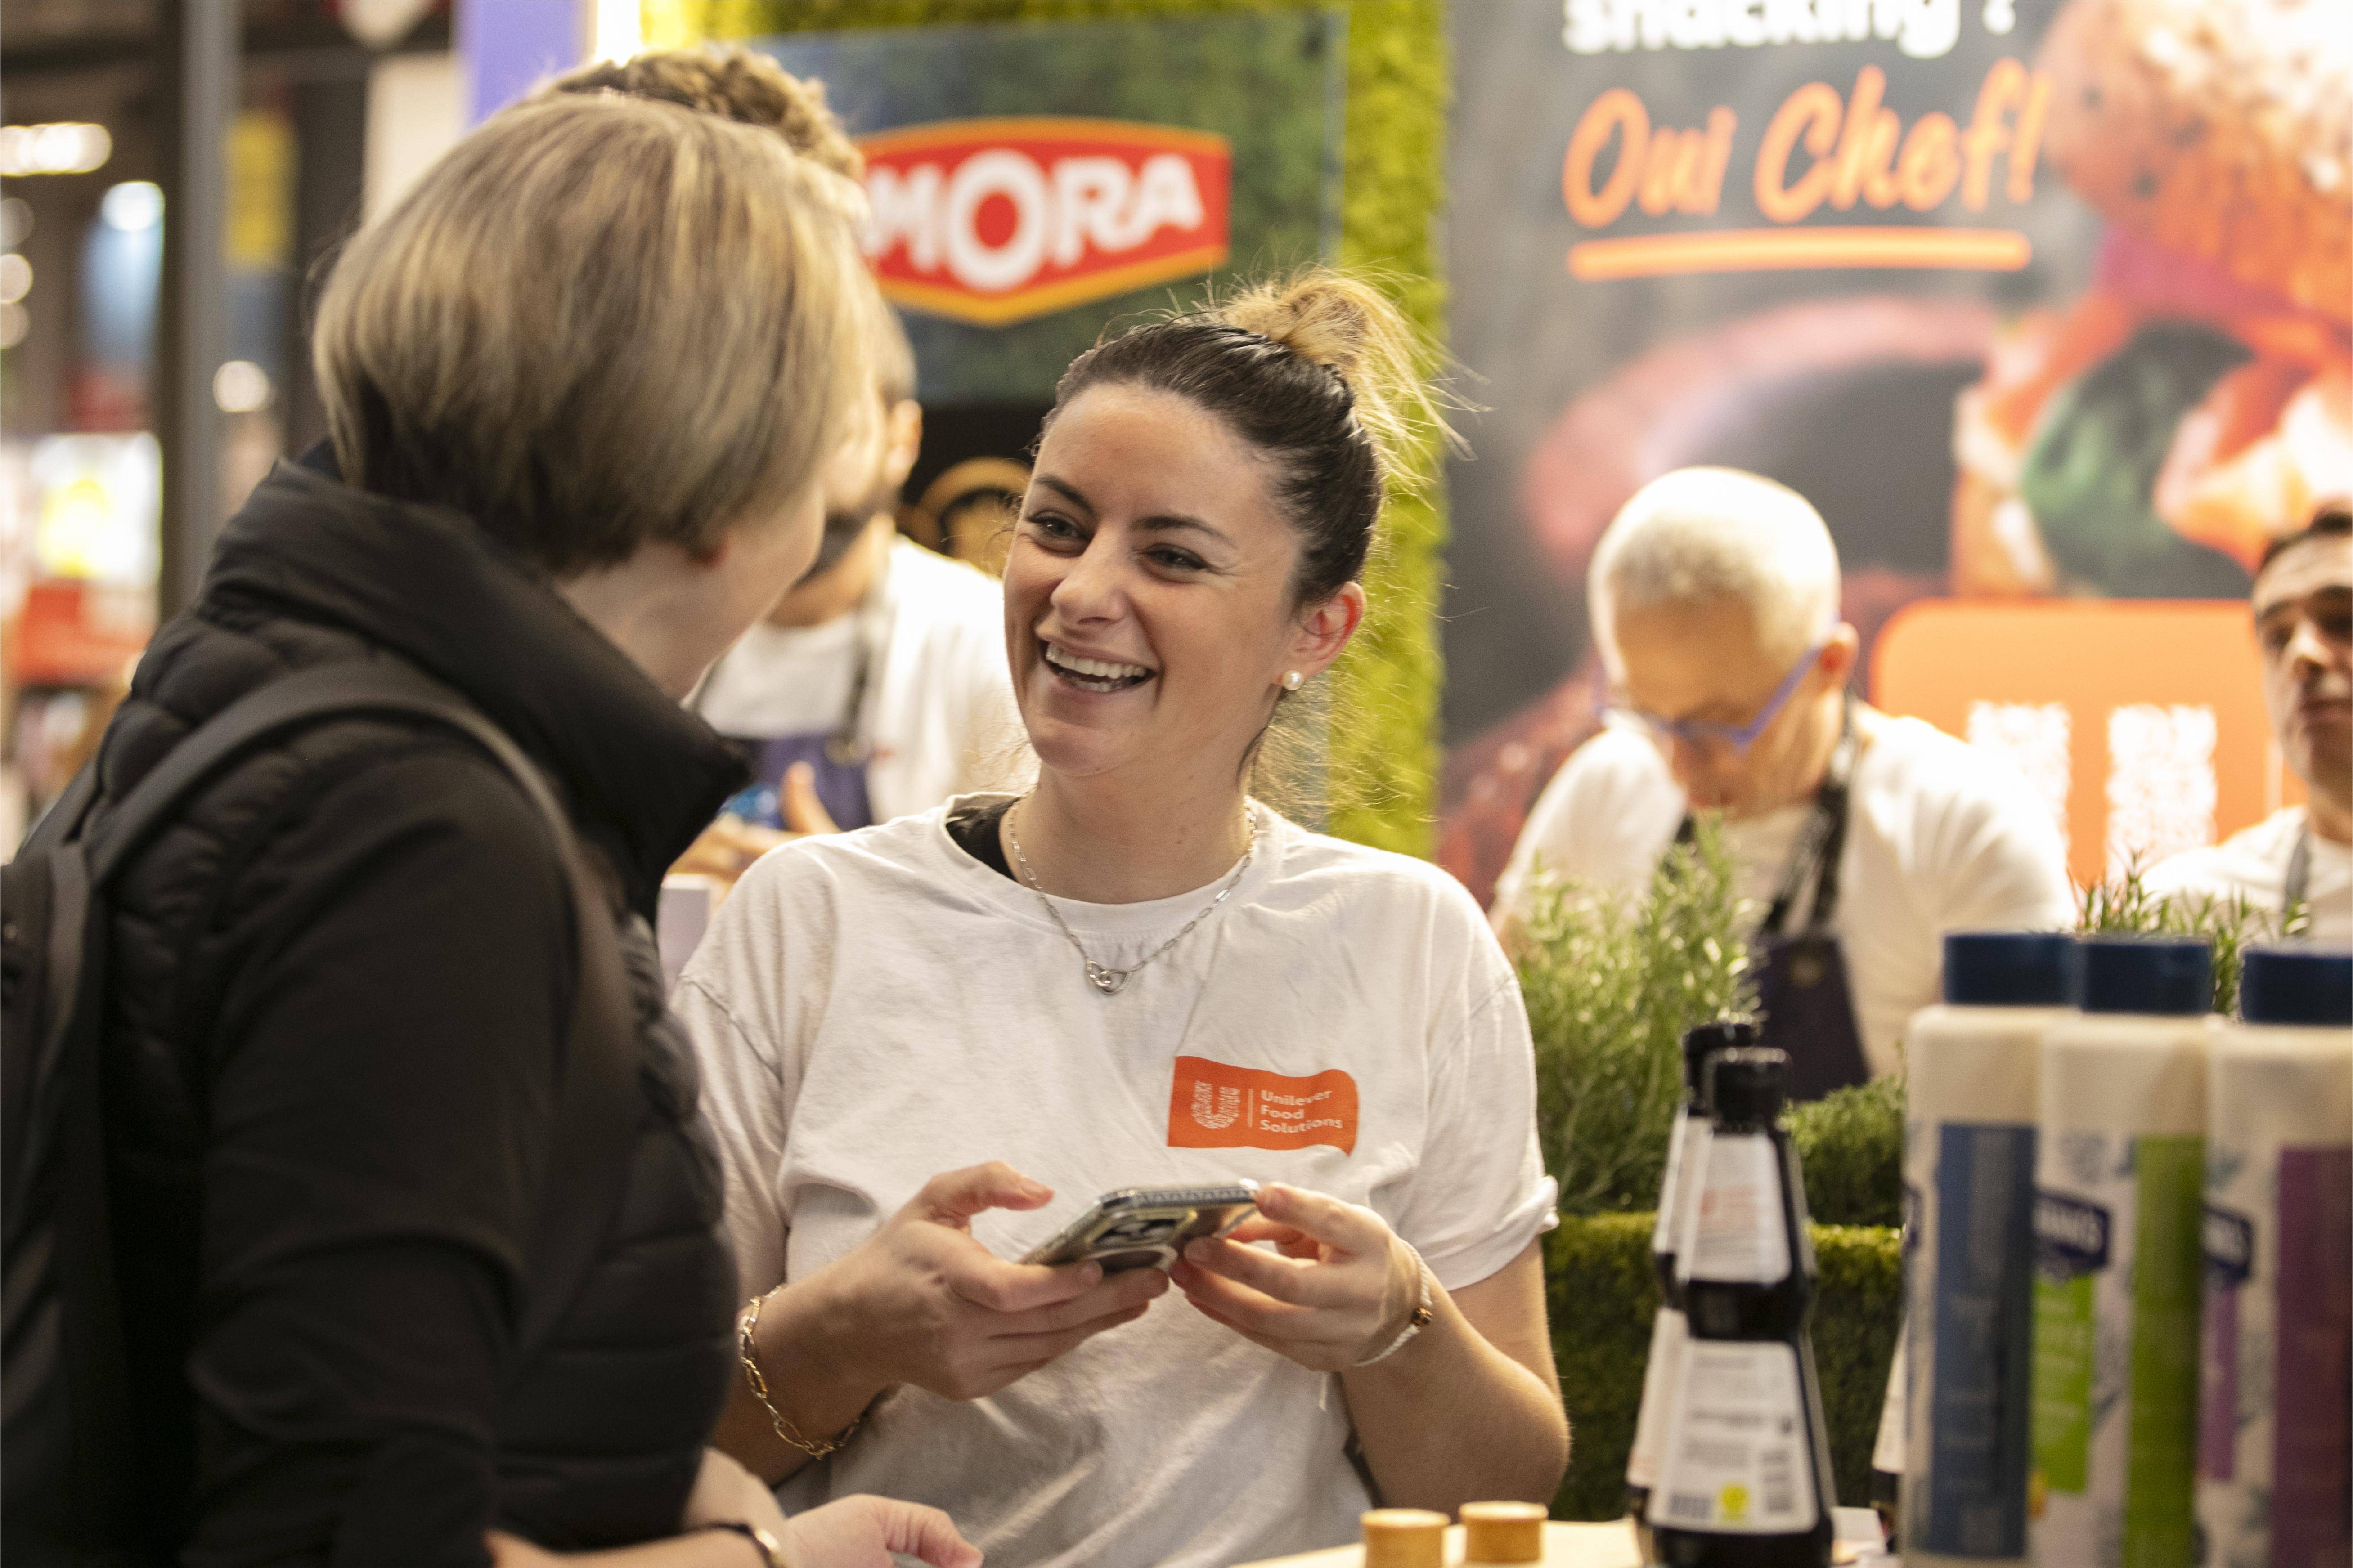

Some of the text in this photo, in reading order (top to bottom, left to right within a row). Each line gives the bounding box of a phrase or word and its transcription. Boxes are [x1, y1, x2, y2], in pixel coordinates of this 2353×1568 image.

[1562, 57, 2054, 228] Oui Chef!
[862, 148, 1205, 293] MORA
[1261, 1089, 1333, 1106] Unilever
[1260, 1104, 1305, 1119] Food
[1260, 1118, 1343, 1133] Solutions
